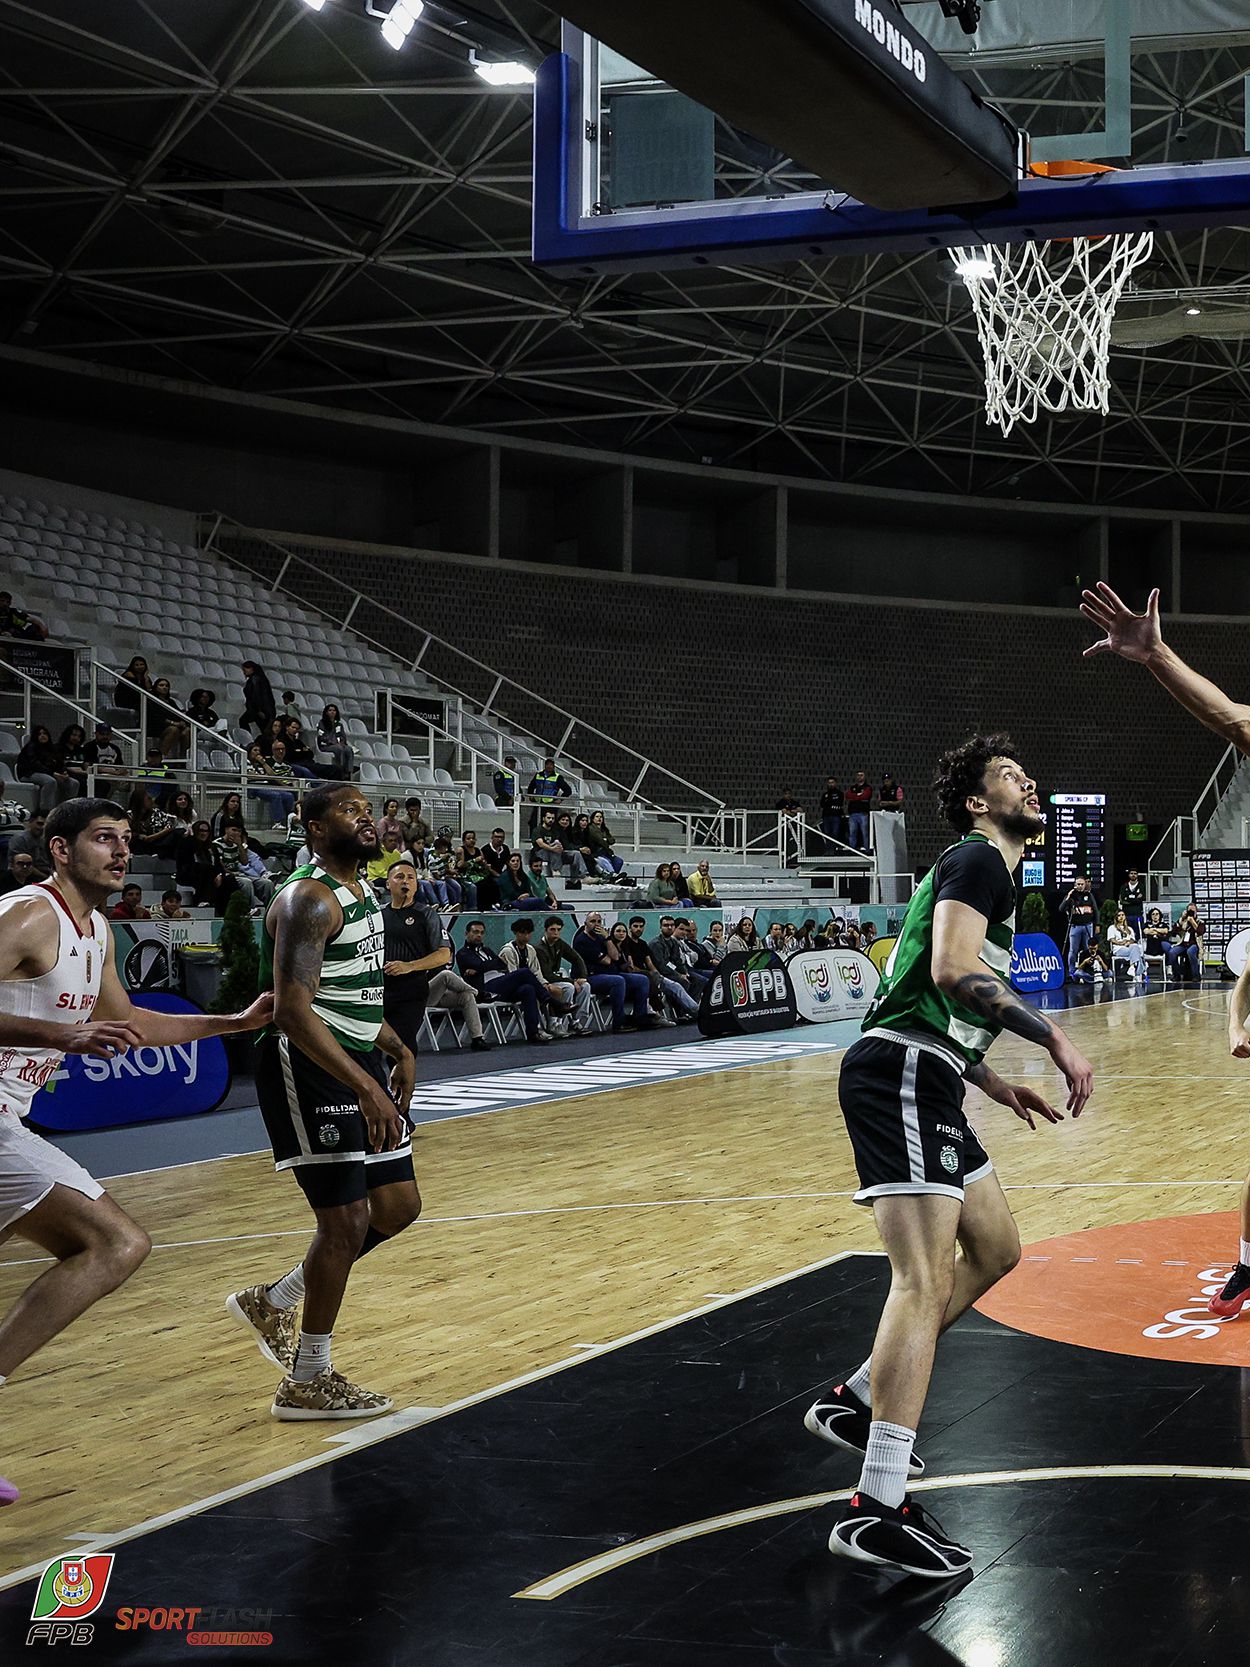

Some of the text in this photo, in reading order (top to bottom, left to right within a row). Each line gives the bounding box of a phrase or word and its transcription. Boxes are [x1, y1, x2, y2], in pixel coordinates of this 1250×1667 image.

[855, 0, 925, 82] MONDO
[171, 929, 188, 943] TAÇA
[1012, 948, 1060, 982] Culligan
[56, 992, 76, 1010] SL
[748, 969, 788, 1004] FPB
